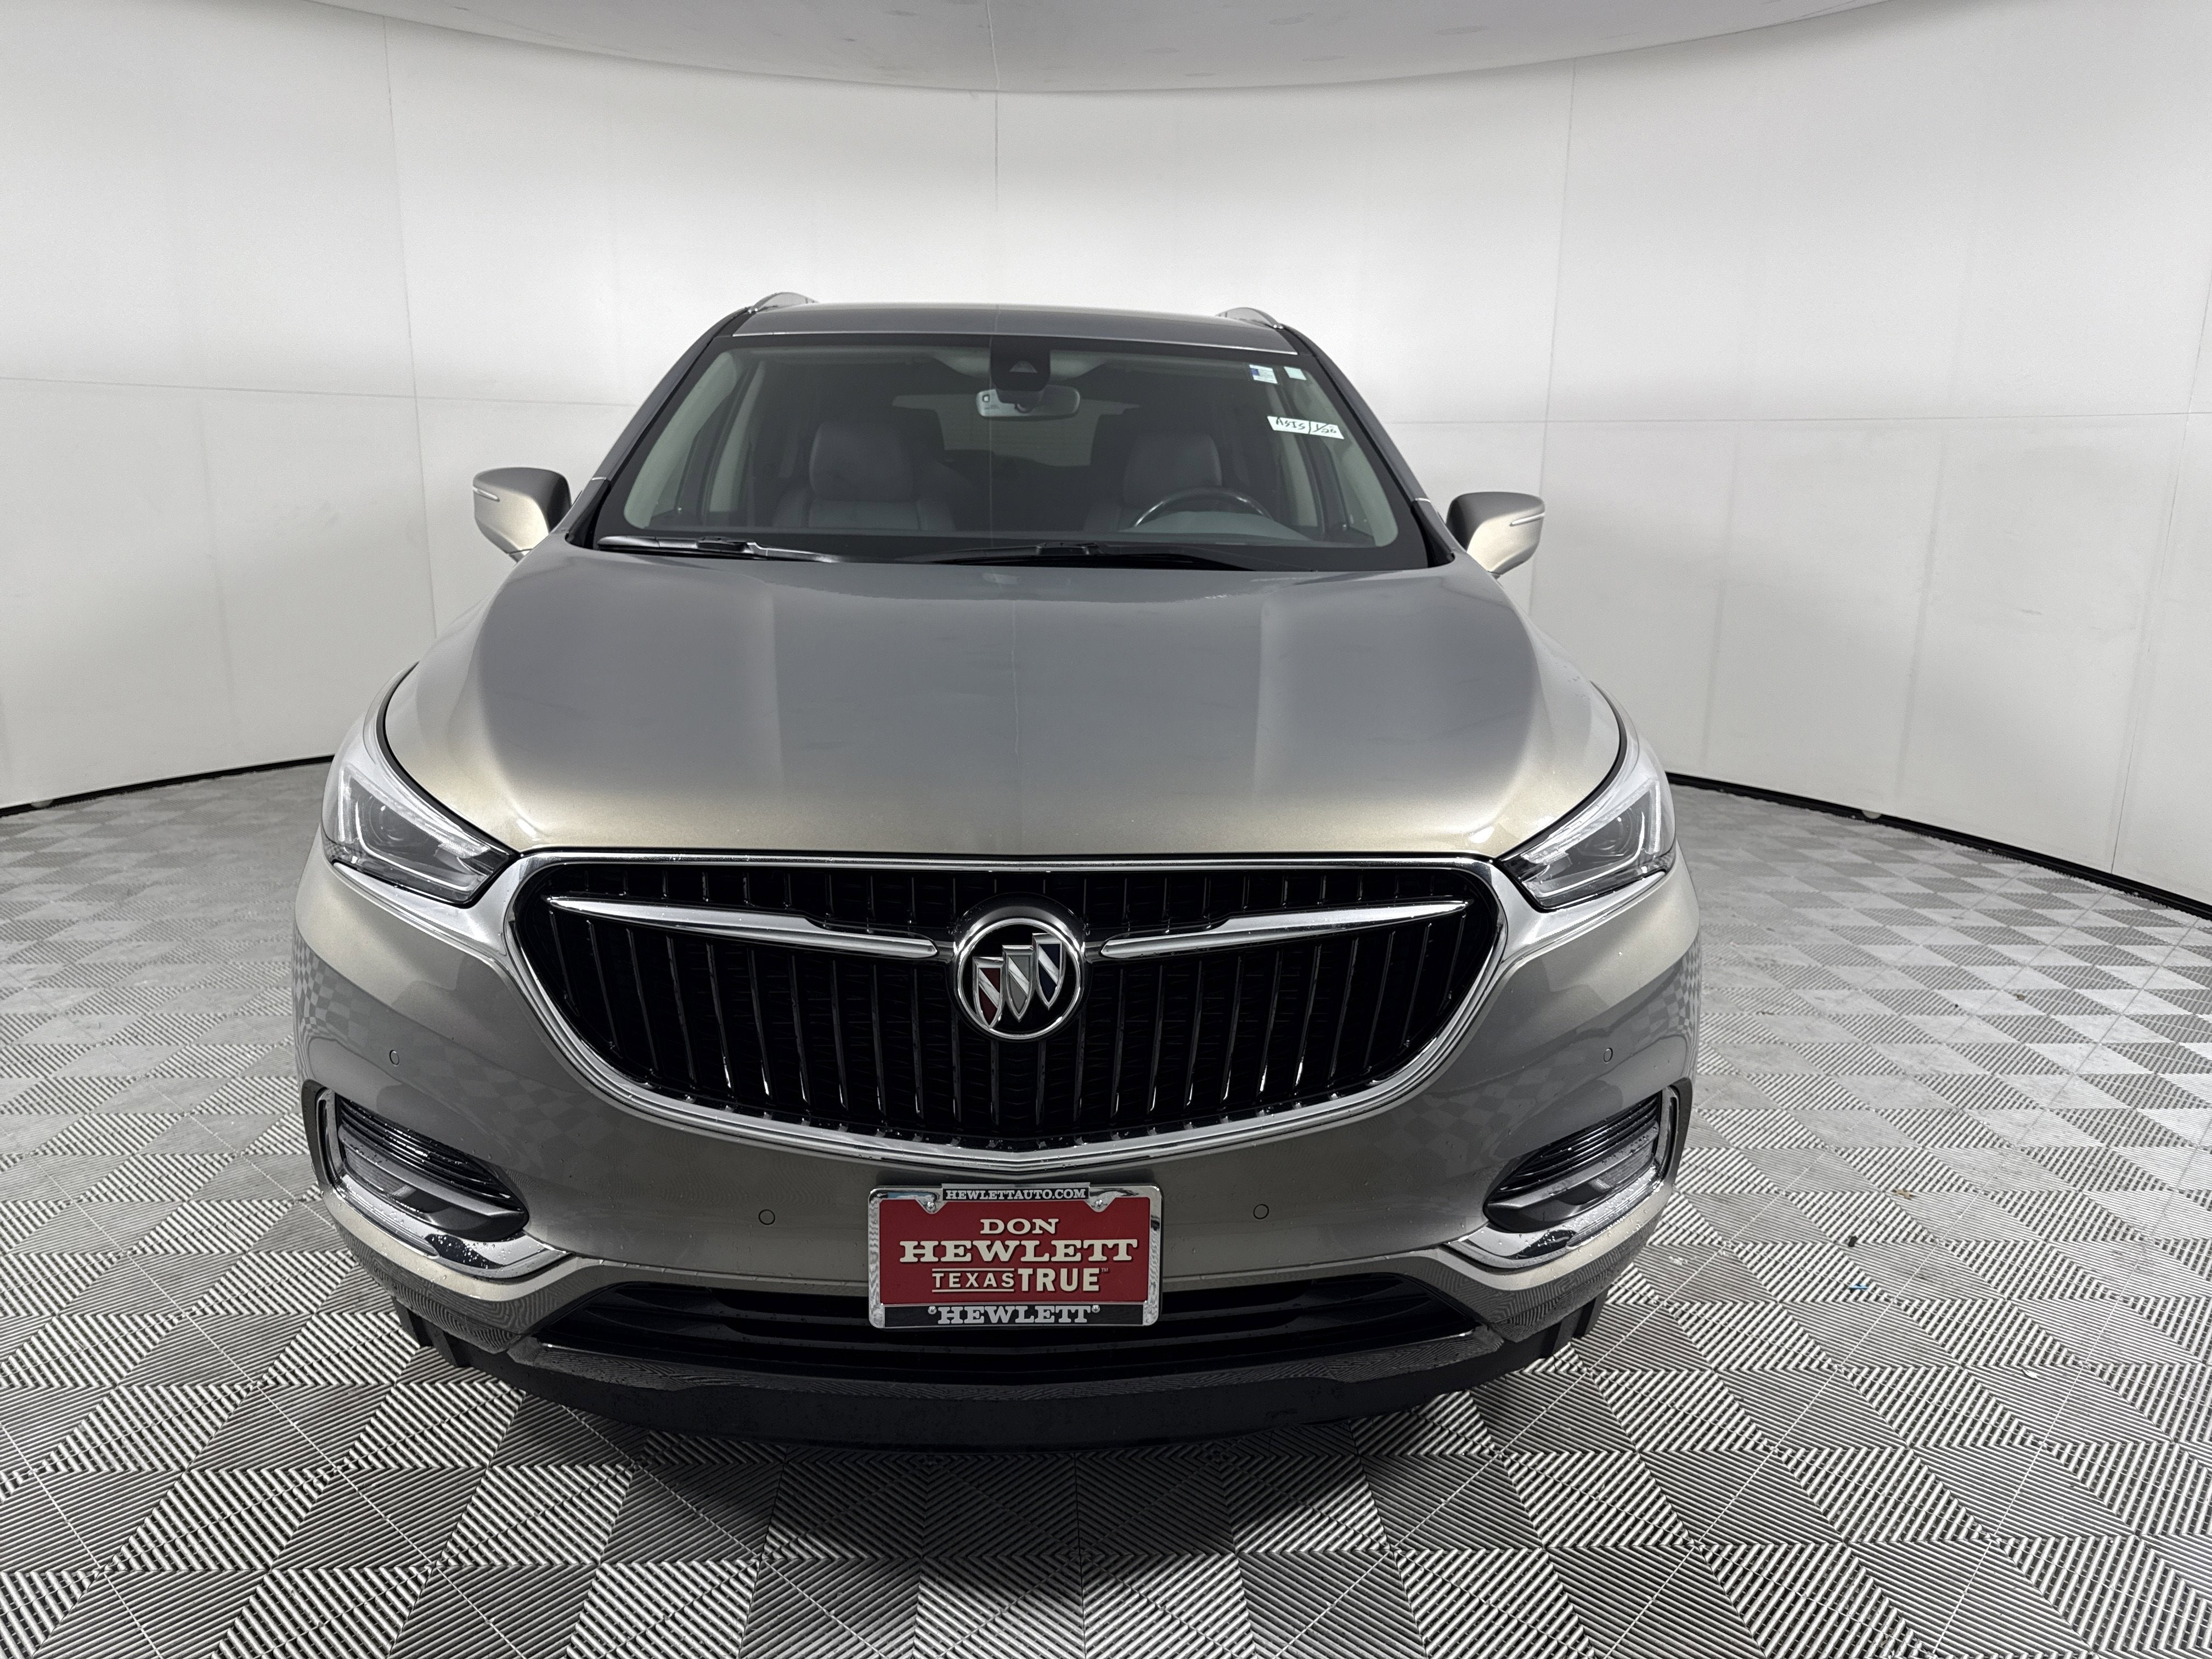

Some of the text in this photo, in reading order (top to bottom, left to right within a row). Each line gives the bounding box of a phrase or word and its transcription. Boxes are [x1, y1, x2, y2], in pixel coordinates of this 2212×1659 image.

[946, 1189, 1086, 1200] HEWLETTAUTO.COM
[980, 1218, 1059, 1235] DON
[899, 1239, 1138, 1263] HEWLETT
[938, 1306, 1091, 1324] HEWLETT
